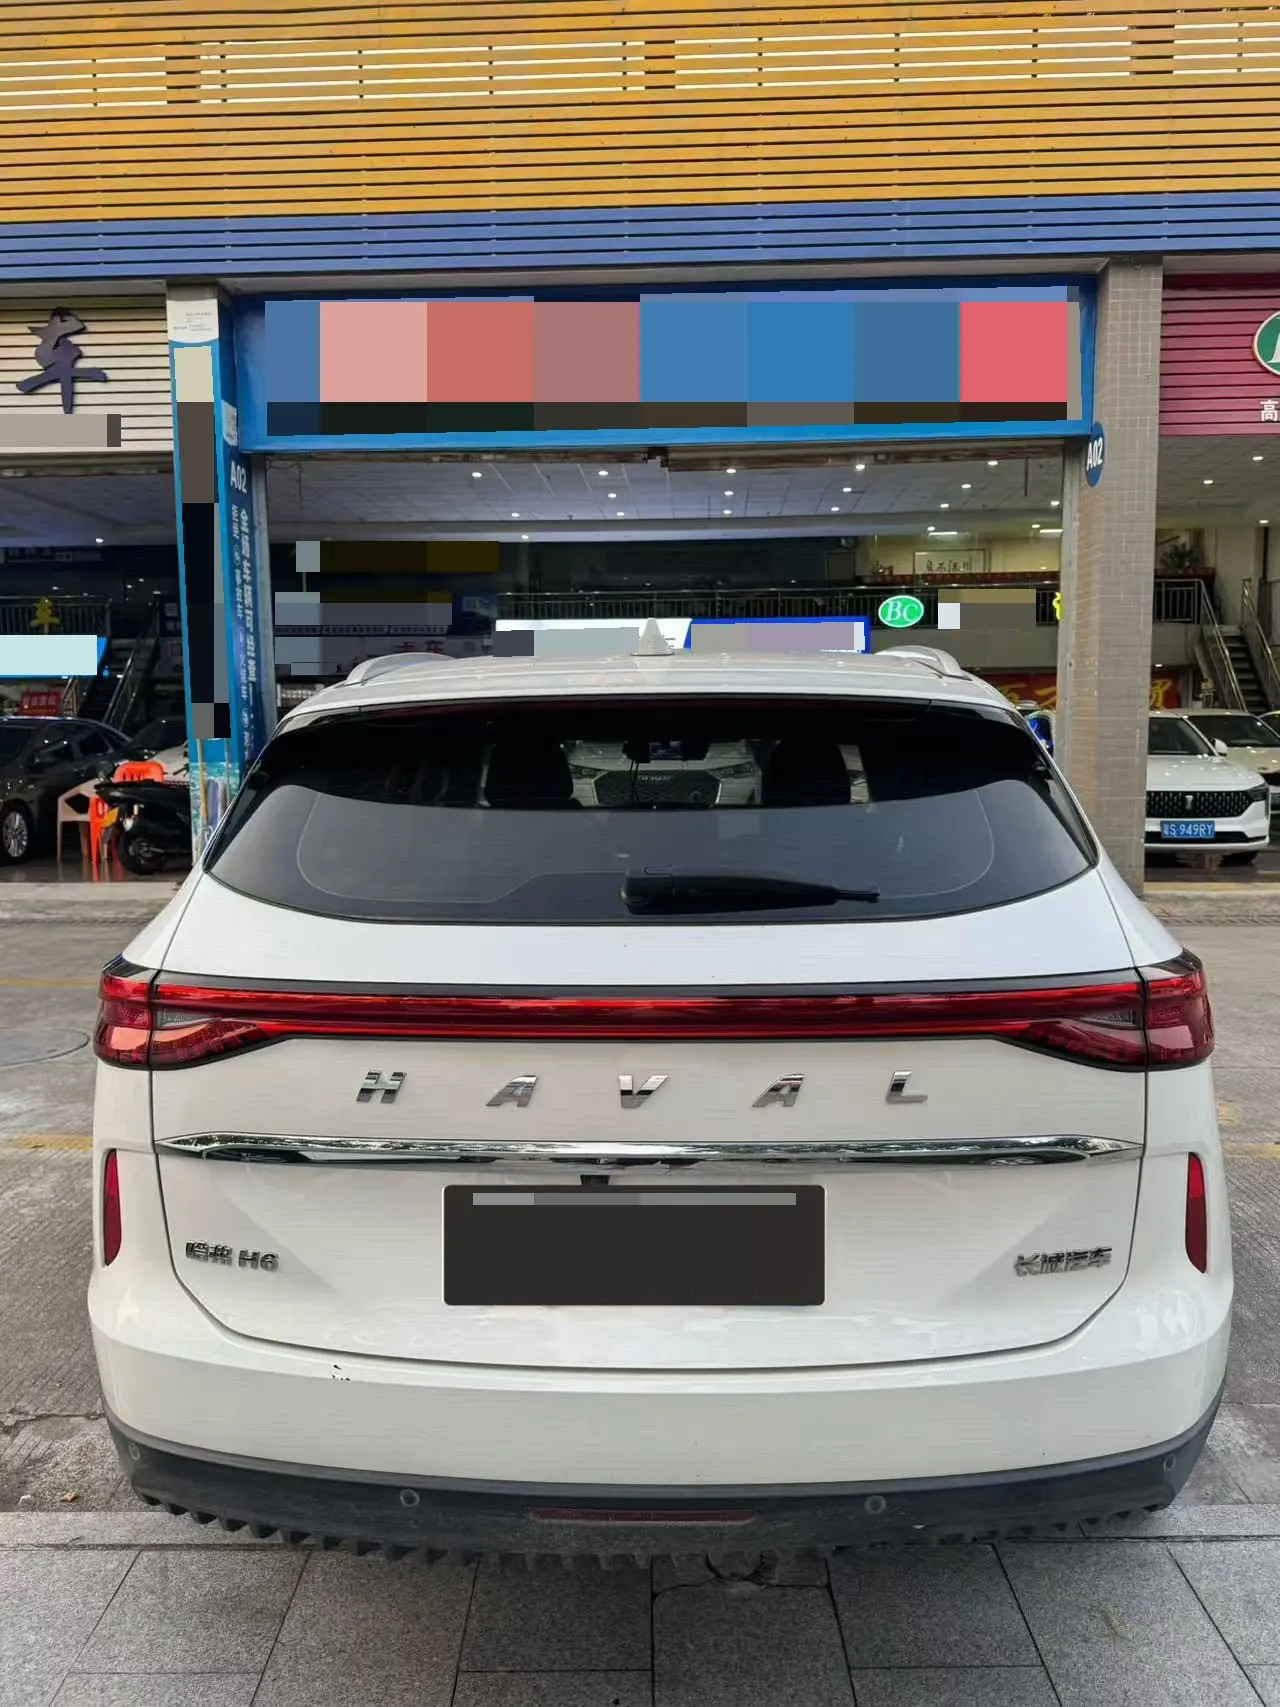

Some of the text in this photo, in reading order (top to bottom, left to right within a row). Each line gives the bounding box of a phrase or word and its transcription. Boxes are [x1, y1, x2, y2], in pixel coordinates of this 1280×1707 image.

[1086, 439, 1103, 471] A02
[230, 460, 248, 493] A02
[885, 600, 918, 622] BC
[356, 1070, 929, 1109] HAVAL
[238, 1249, 280, 1272] H6
